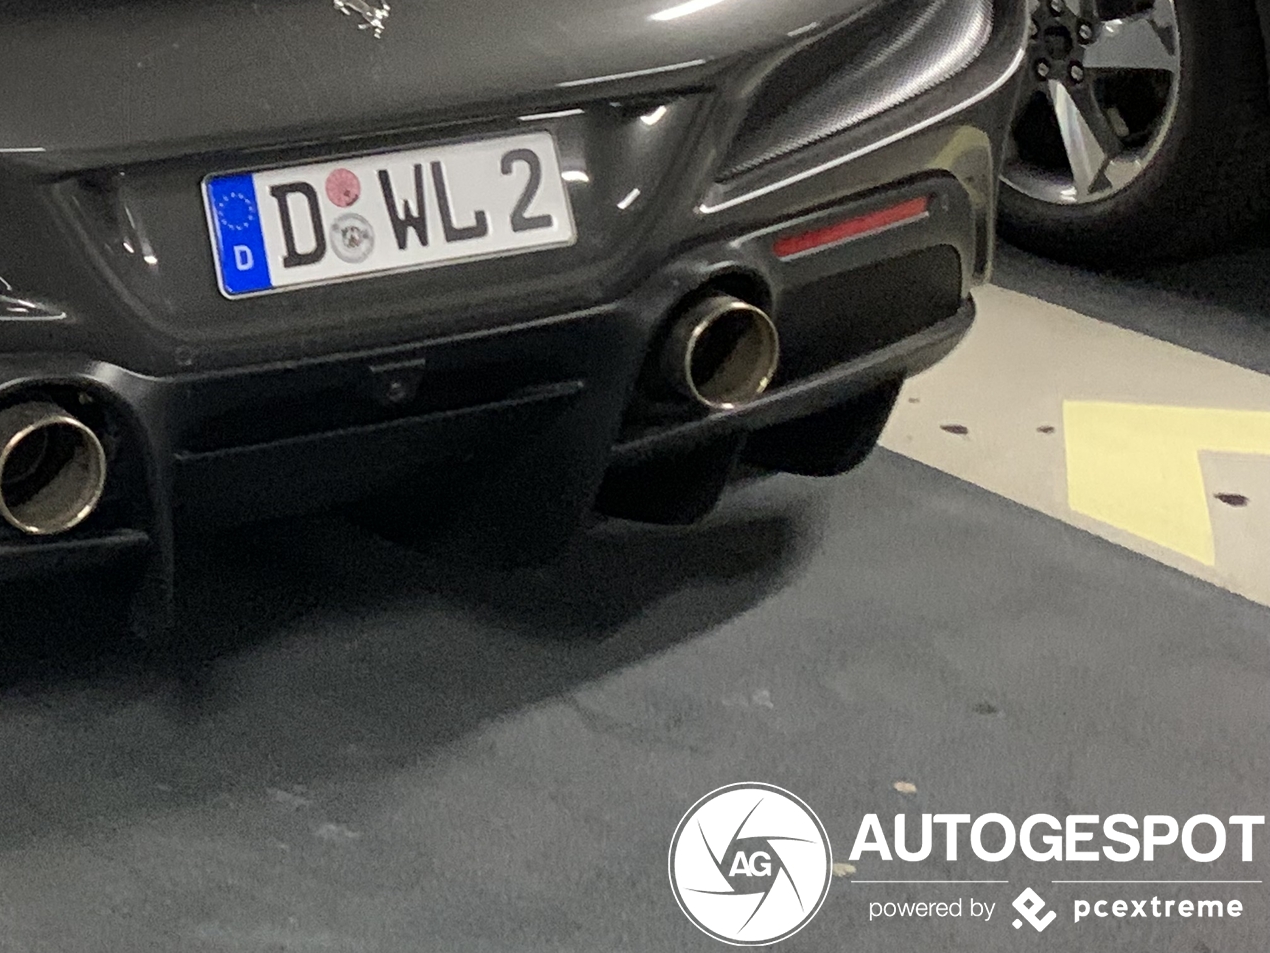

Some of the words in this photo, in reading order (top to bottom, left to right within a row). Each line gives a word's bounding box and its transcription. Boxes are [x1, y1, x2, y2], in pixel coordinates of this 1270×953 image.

[270, 181, 327, 268] D
[378, 160, 488, 250] WL
[500, 148, 553, 232] 2
[234, 245, 254, 272] D
